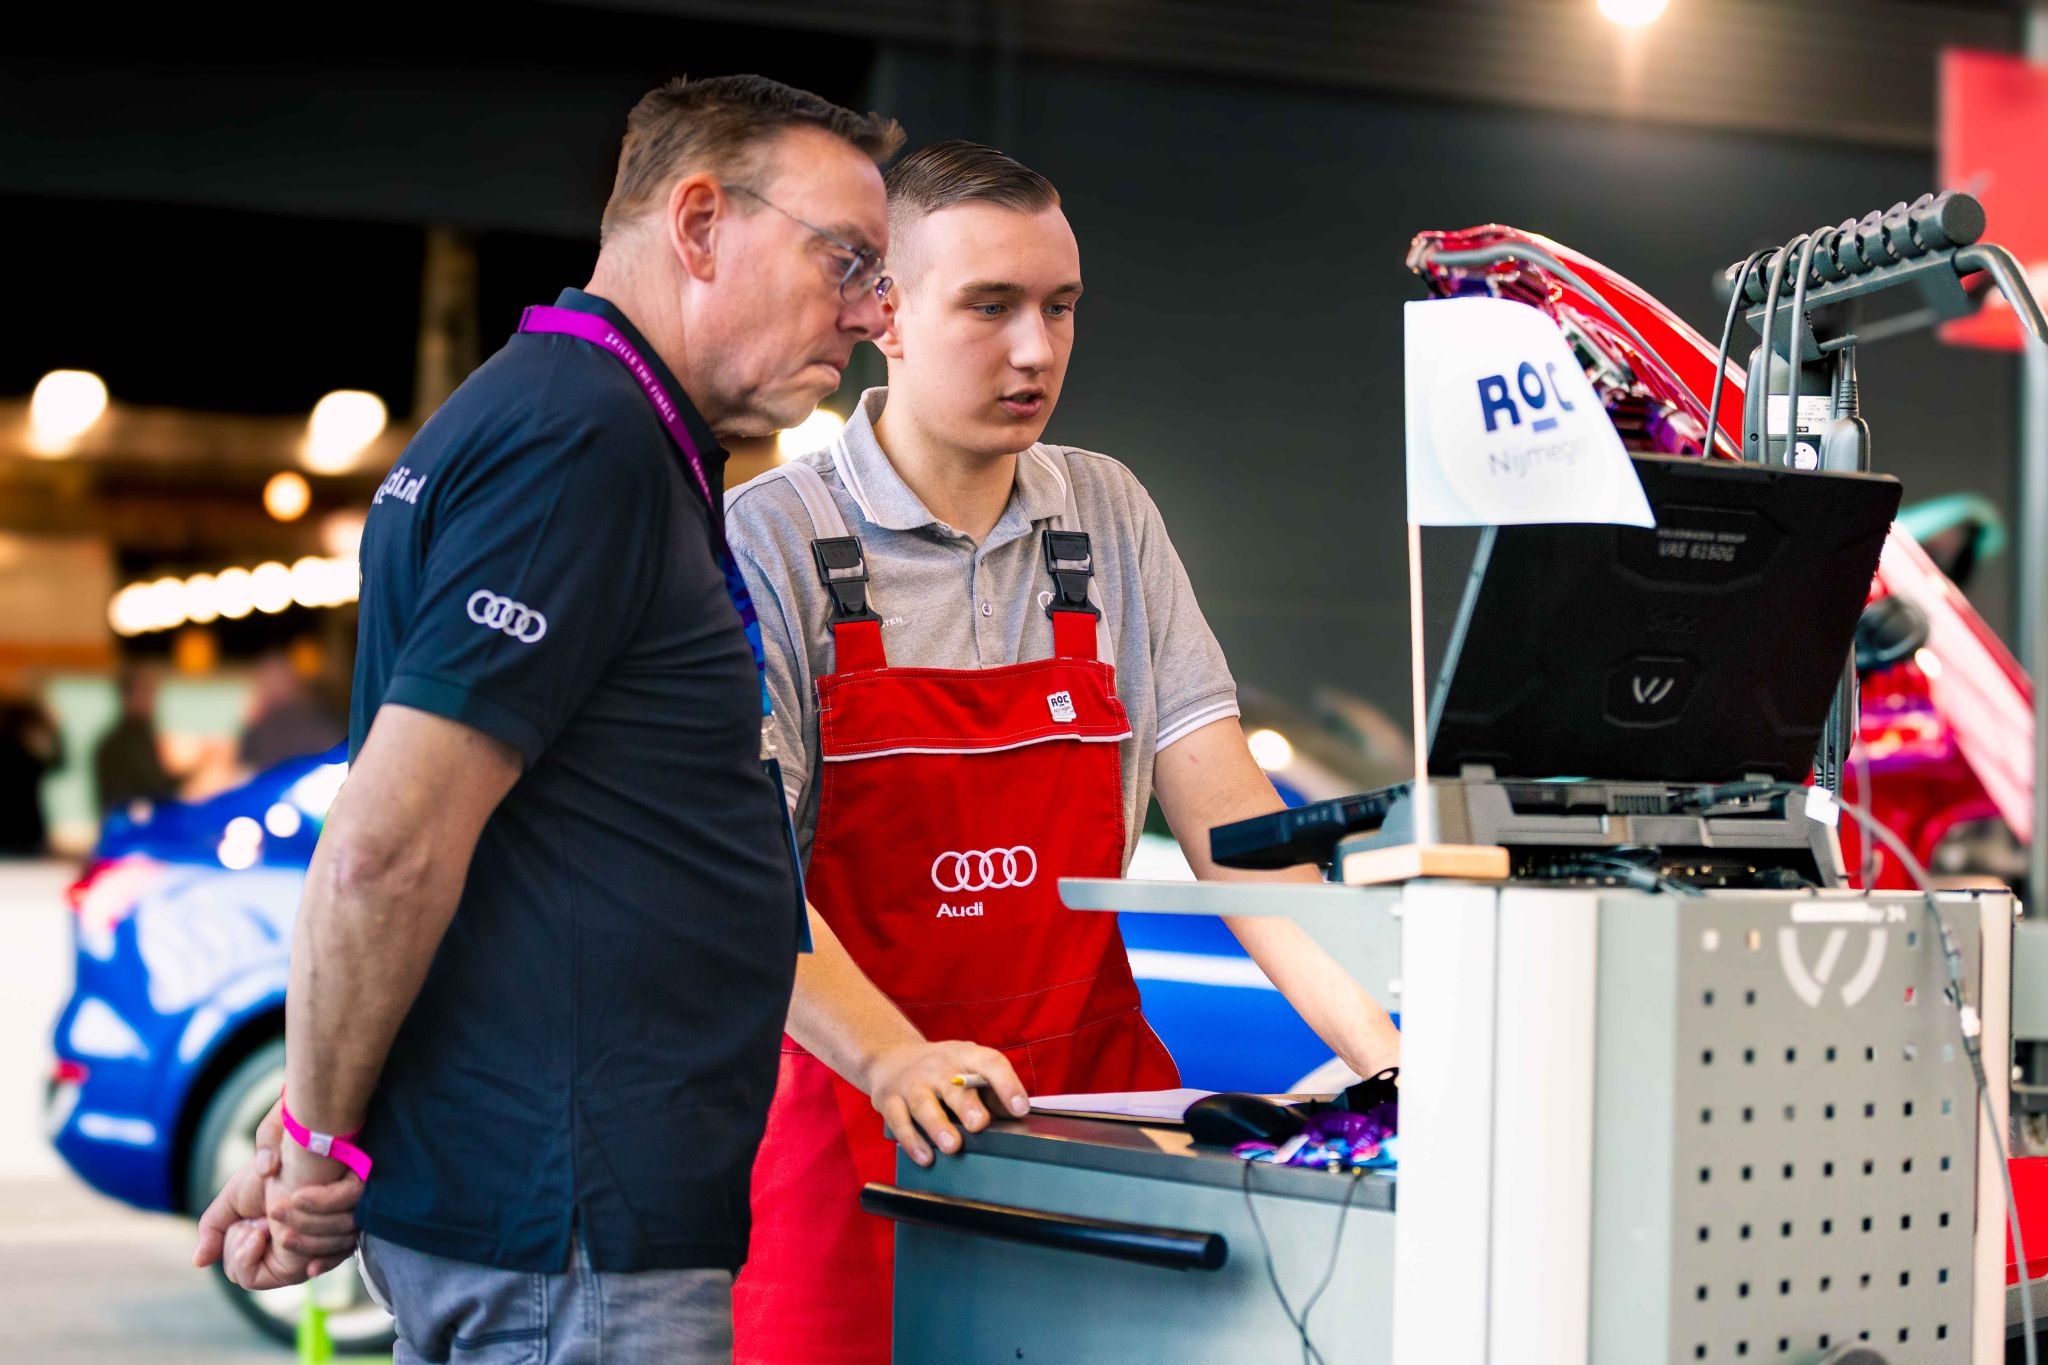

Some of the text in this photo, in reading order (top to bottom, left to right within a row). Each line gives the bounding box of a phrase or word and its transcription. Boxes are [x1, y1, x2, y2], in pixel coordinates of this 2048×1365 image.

[605, 333, 676, 422] SKILLS THE FINALS
[1477, 361, 1575, 433] ROC
[1659, 541, 1687, 558] VAS
[1051, 694, 1070, 707] ROC
[936, 902, 984, 918] Audi
